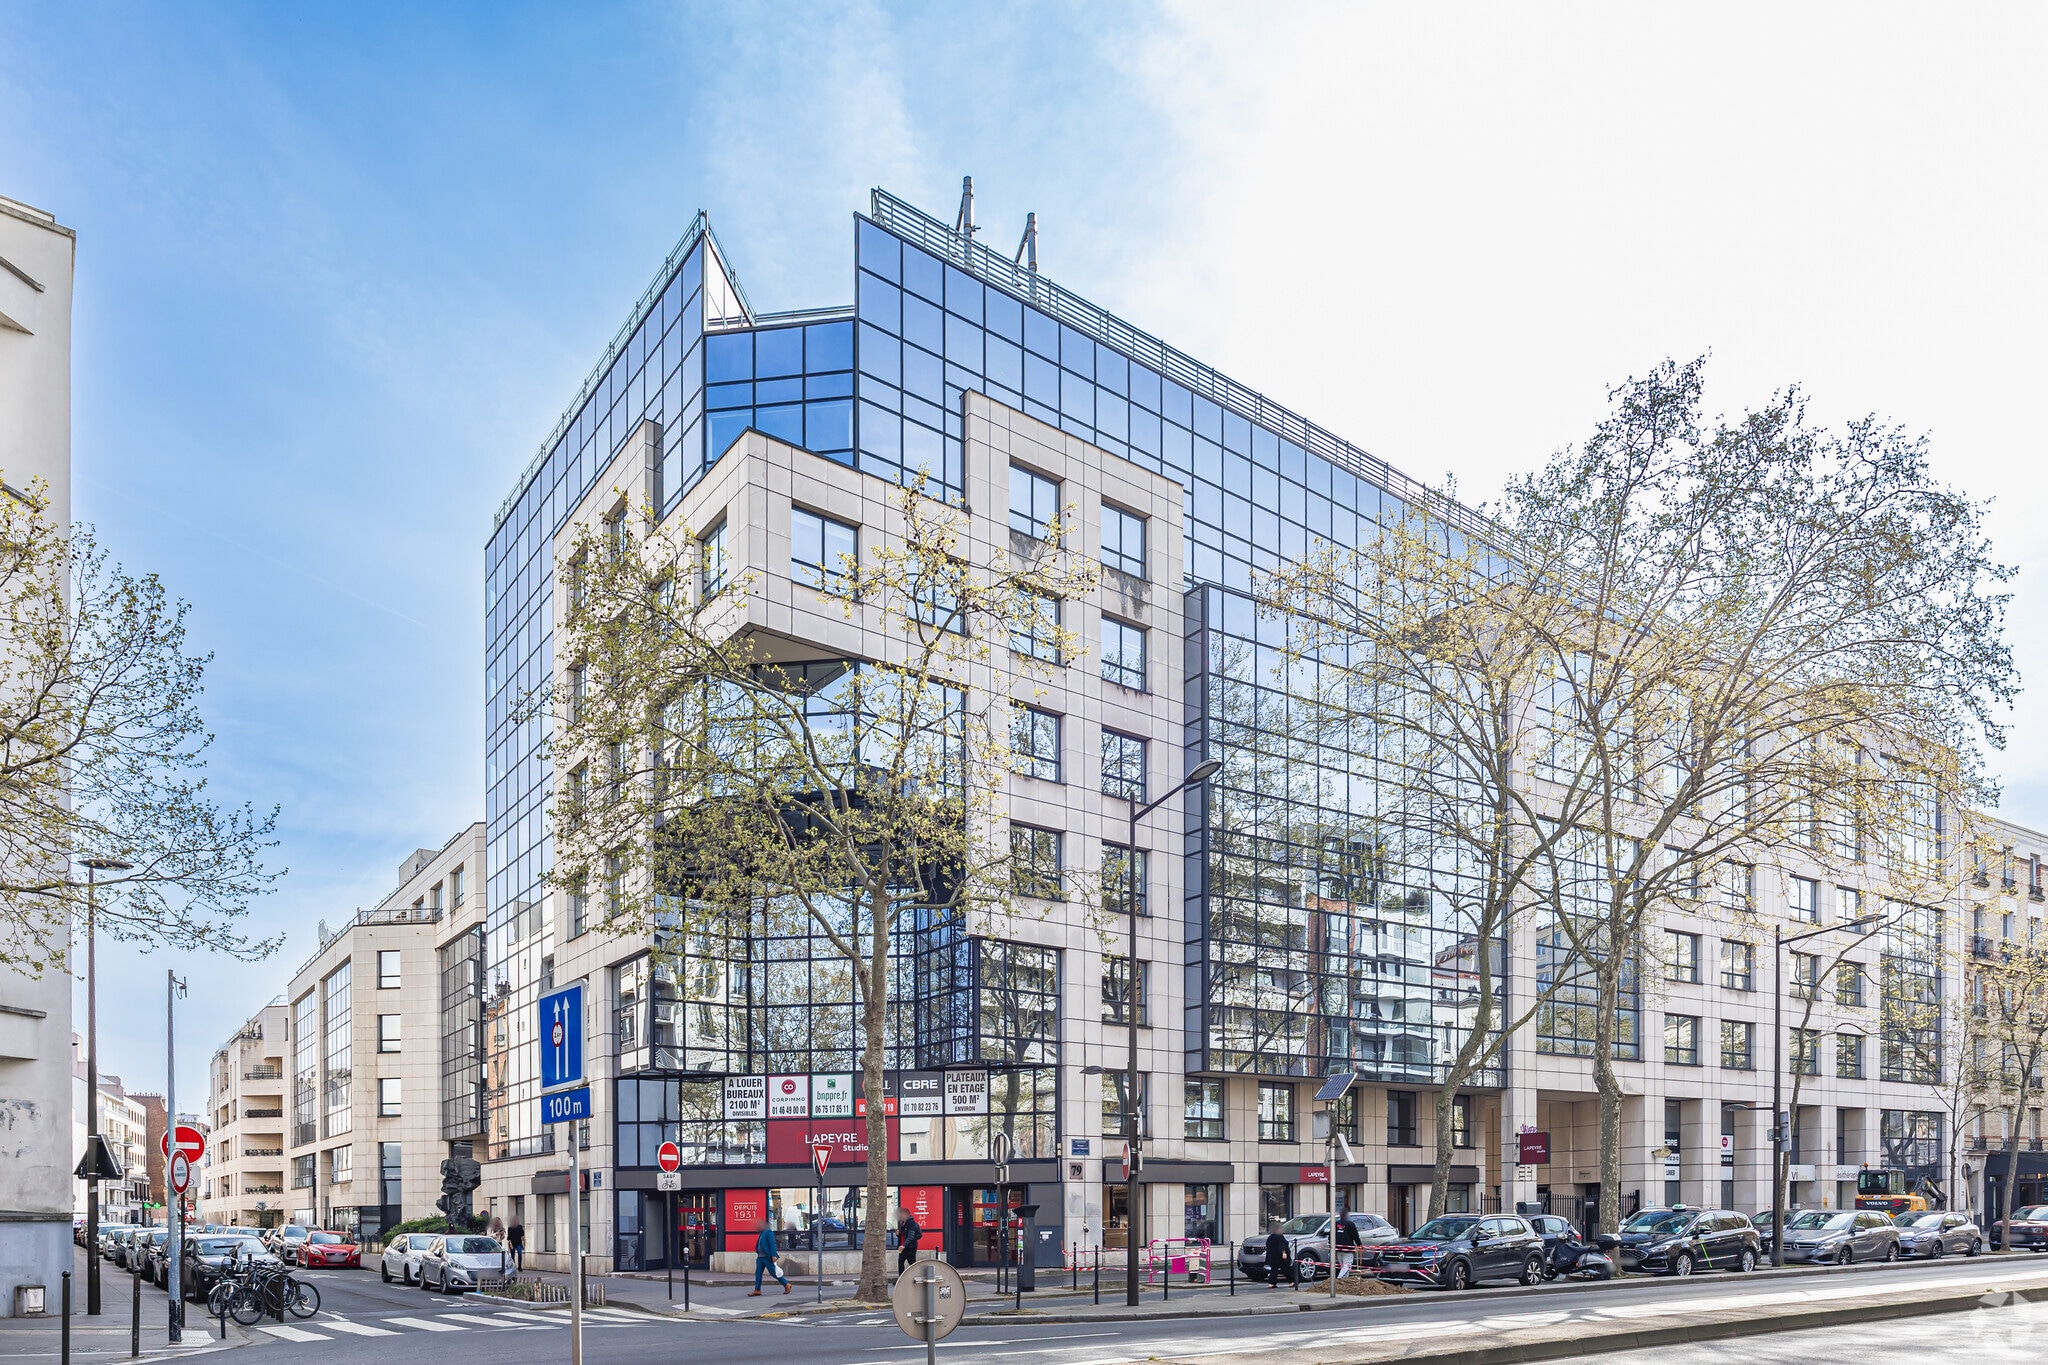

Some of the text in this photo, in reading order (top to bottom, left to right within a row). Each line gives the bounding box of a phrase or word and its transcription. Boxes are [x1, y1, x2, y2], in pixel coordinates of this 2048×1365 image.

[946, 1073, 986, 1082] PLATEAUX
[728, 1078, 762, 1088] A LOUER
[903, 1079, 938, 1090] CBRE
[948, 1084, 985, 1093] EN ETAGE
[726, 1089, 764, 1099] BUREAUX
[816, 1090, 848, 1102] bnppre.fr
[952, 1095, 967, 1104] 500
[549, 1096, 582, 1118] 100 m
[729, 1100, 749, 1110] 2100
[822, 1105, 829, 1113] 75
[829, 1105, 836, 1113] 17
[843, 1104, 849, 1113] 11
[904, 1102, 939, 1112] 01 70 82 23 76
[805, 1133, 858, 1144] LAPEYRE
[842, 1143, 869, 1152] Studio
[1071, 1165, 1083, 1176] 79
[734, 1211, 757, 1219] 1931
